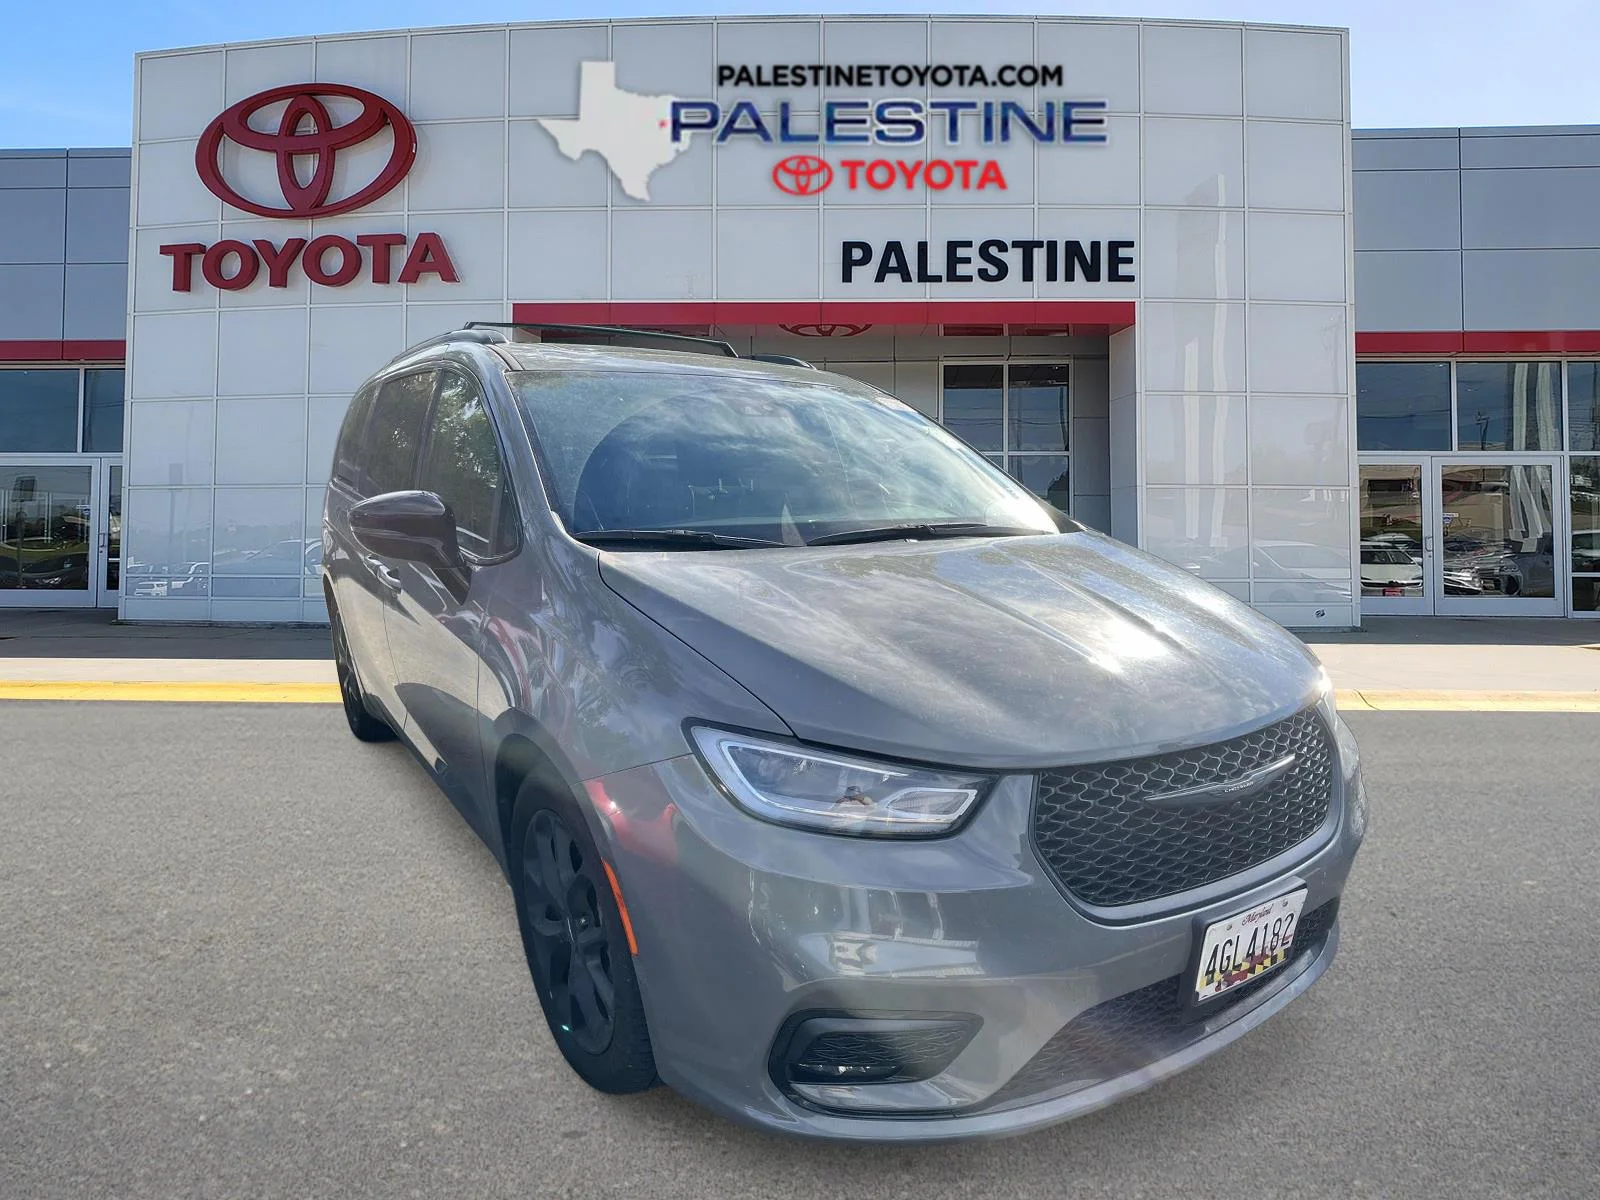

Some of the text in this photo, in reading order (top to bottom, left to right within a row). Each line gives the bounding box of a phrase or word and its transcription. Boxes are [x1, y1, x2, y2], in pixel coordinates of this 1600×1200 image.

[160, 232, 460, 292] TOYOTA
[841, 239, 1135, 283] PALESTINE
[1204, 912, 1295, 982] 4GL4182
